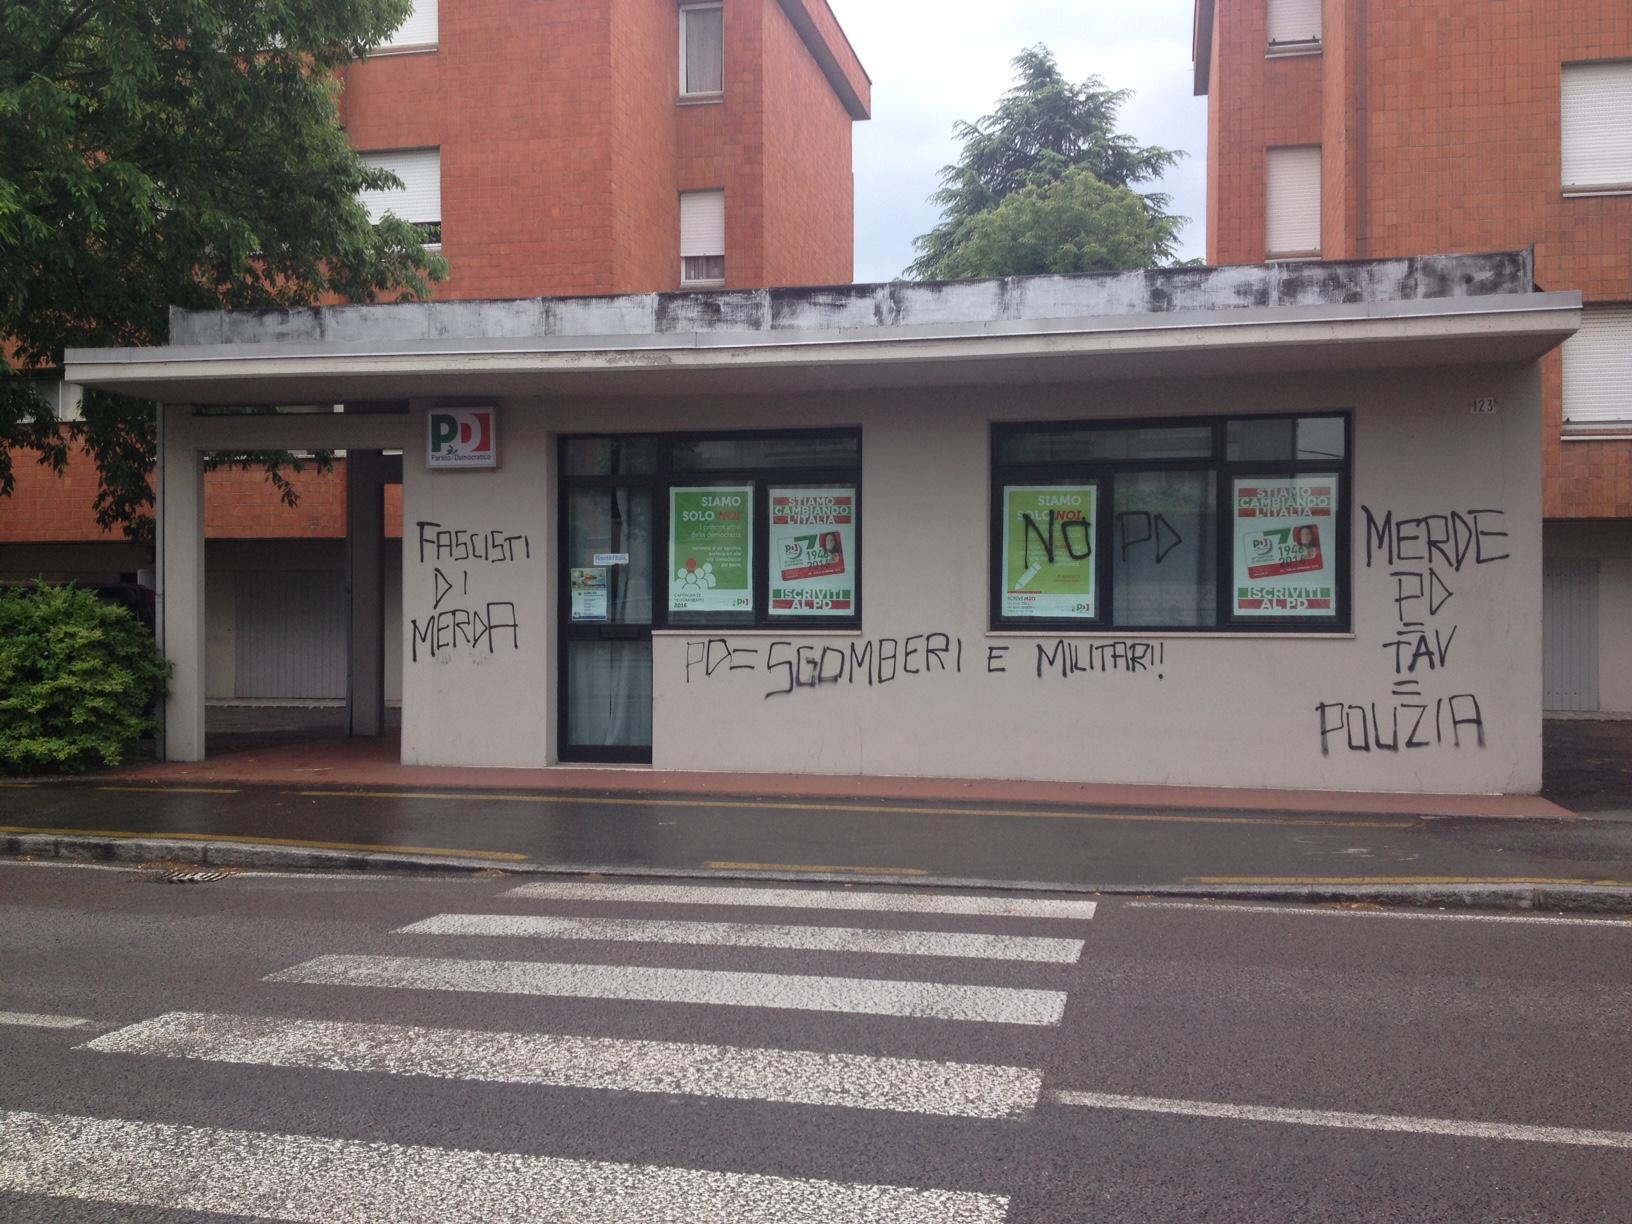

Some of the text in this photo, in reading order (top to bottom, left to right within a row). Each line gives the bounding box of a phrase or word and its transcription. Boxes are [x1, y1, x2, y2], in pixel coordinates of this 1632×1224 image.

[1473, 399, 1493, 412] 123
[431, 413, 490, 452] PD
[1257, 487, 1311, 497] STIAMO
[702, 496, 741, 506] SIAMO
[788, 497, 834, 506] STIAMO
[1038, 495, 1081, 506] SIAMO
[1240, 497, 1329, 507] CAMBIANDO
[682, 511, 715, 521] SOLO
[775, 506, 849, 515] CAMBIANDO
[1255, 507, 1312, 517] L'ITALIA
[787, 515, 836, 524] L'ITALIA
[416, 521, 530, 563] FASCISTI
[1023, 509, 1091, 569] NO
[1116, 511, 1183, 564] PD
[1361, 505, 1510, 571] MERDE
[433, 567, 467, 610] DI
[780, 589, 843, 599] ISCRIVITI
[1248, 587, 1320, 598] ISCRIVITI
[1390, 567, 1454, 622] PD
[791, 600, 832, 609] AL PD
[1260, 599, 1308, 609] AL PD
[411, 602, 518, 662] MERDA
[1382, 625, 1457, 673] TAV
[764, 632, 962, 700] SGOMBERI
[987, 646, 1010, 672] E
